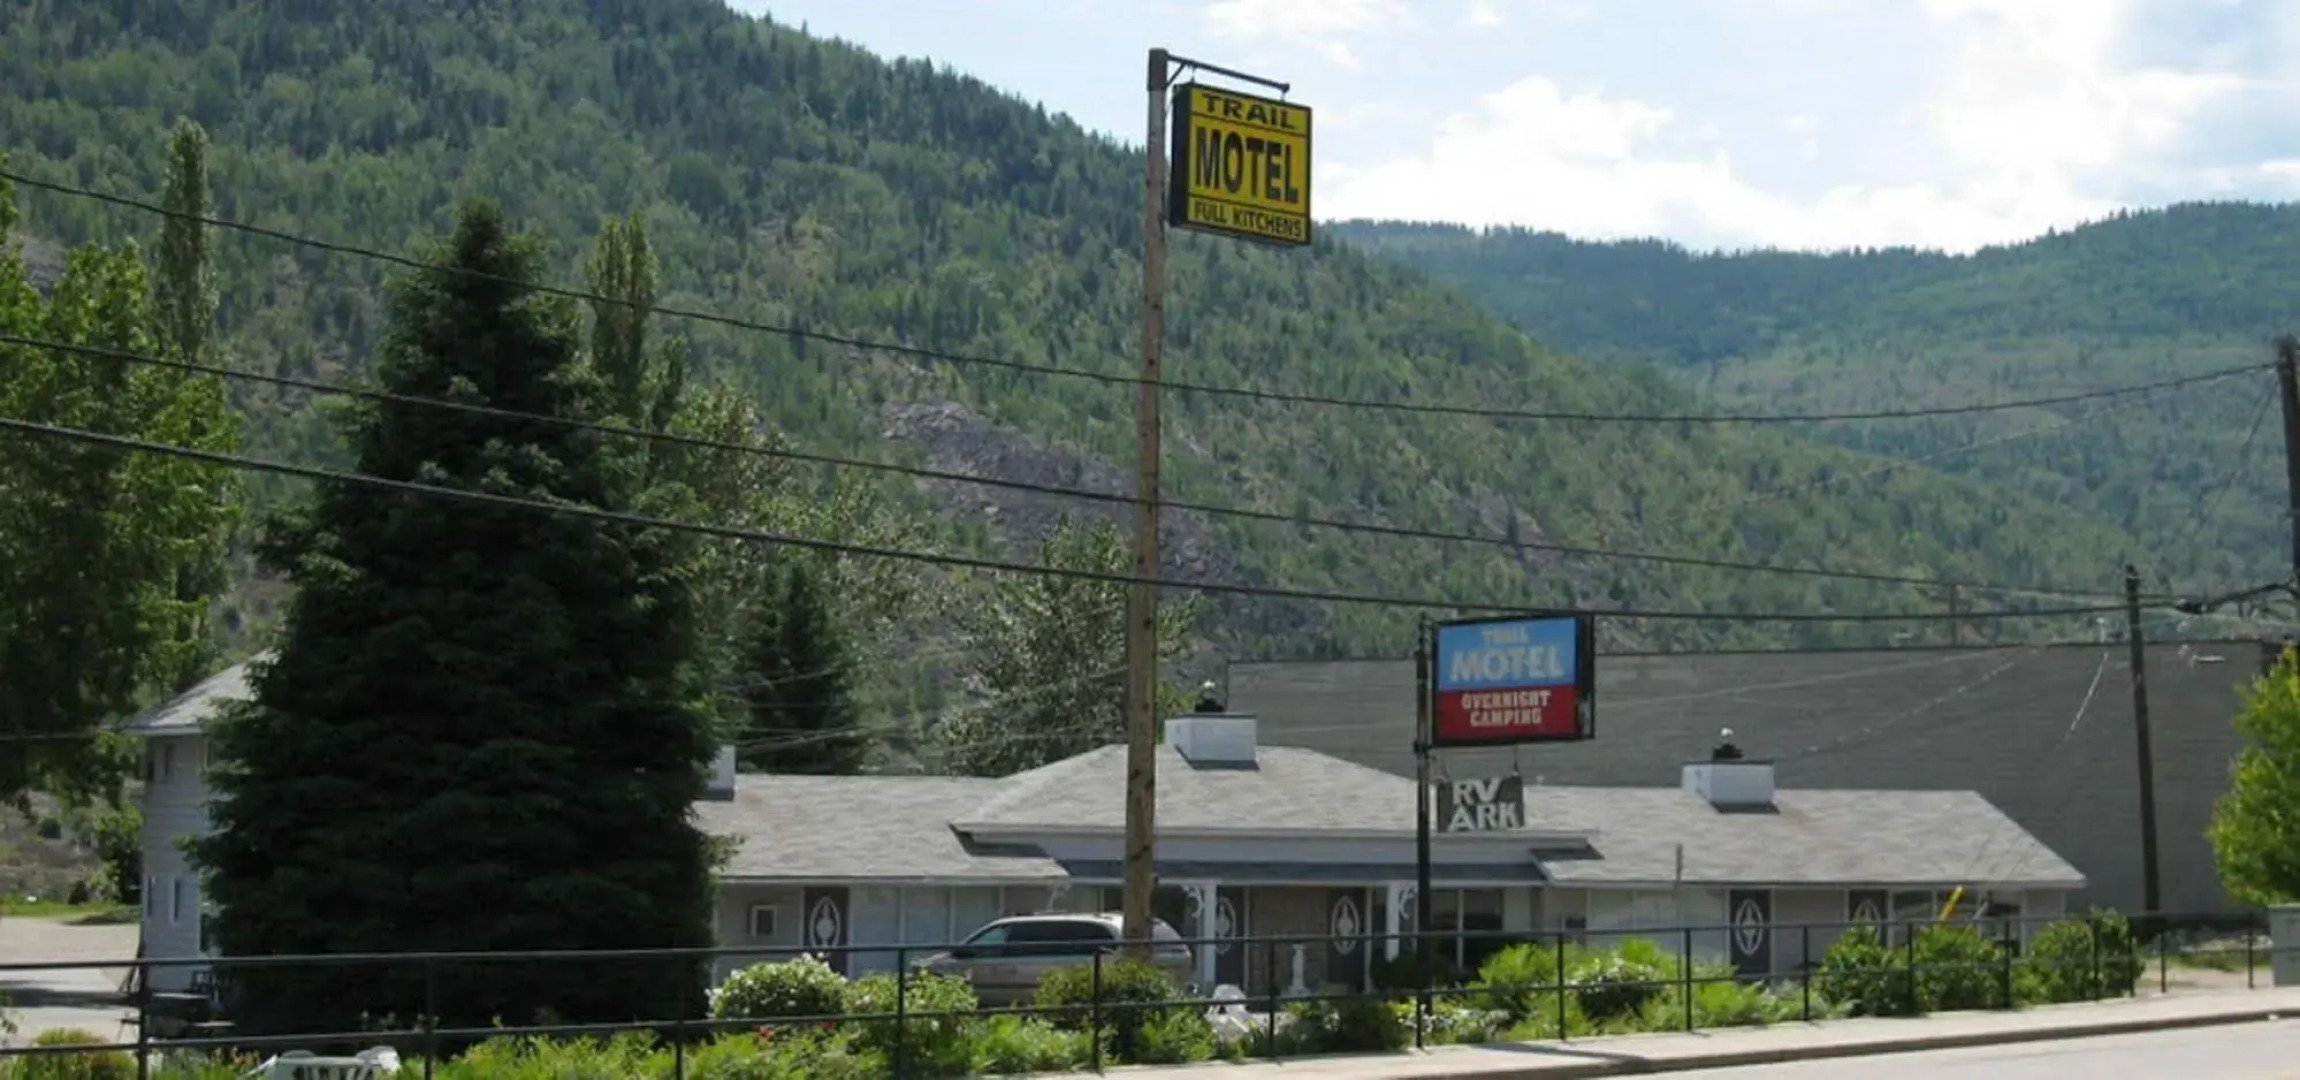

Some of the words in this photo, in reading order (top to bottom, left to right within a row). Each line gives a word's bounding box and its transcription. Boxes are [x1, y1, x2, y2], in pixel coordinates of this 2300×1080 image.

[1202, 94, 1294, 128] TRAIL
[1196, 127, 1299, 203] MOTEL
[1194, 201, 1227, 223] FULL
[1232, 208, 1301, 237] KITCHENS
[1450, 645, 1565, 682] MOTEL
[1461, 690, 1551, 709] OVERNIGHT
[1470, 708, 1541, 726] CAMPING
[1452, 778, 1499, 803] RV
